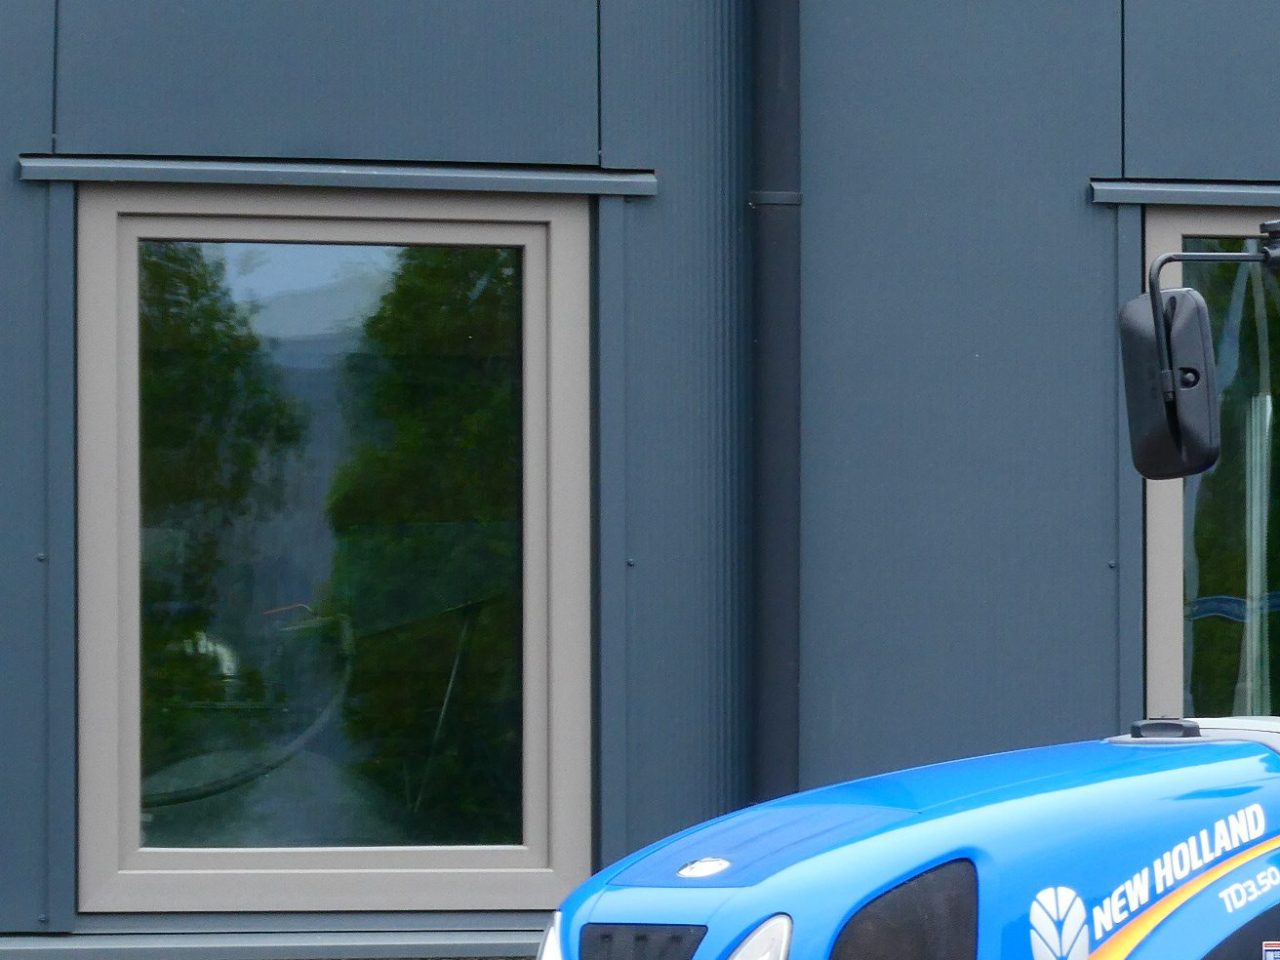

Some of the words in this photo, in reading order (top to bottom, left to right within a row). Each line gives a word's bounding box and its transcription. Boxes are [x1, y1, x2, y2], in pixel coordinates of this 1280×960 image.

[1092, 866, 1149, 940] NEW
[1153, 803, 1265, 894] HOLLAND
[1218, 866, 1280, 913] TD3.50
